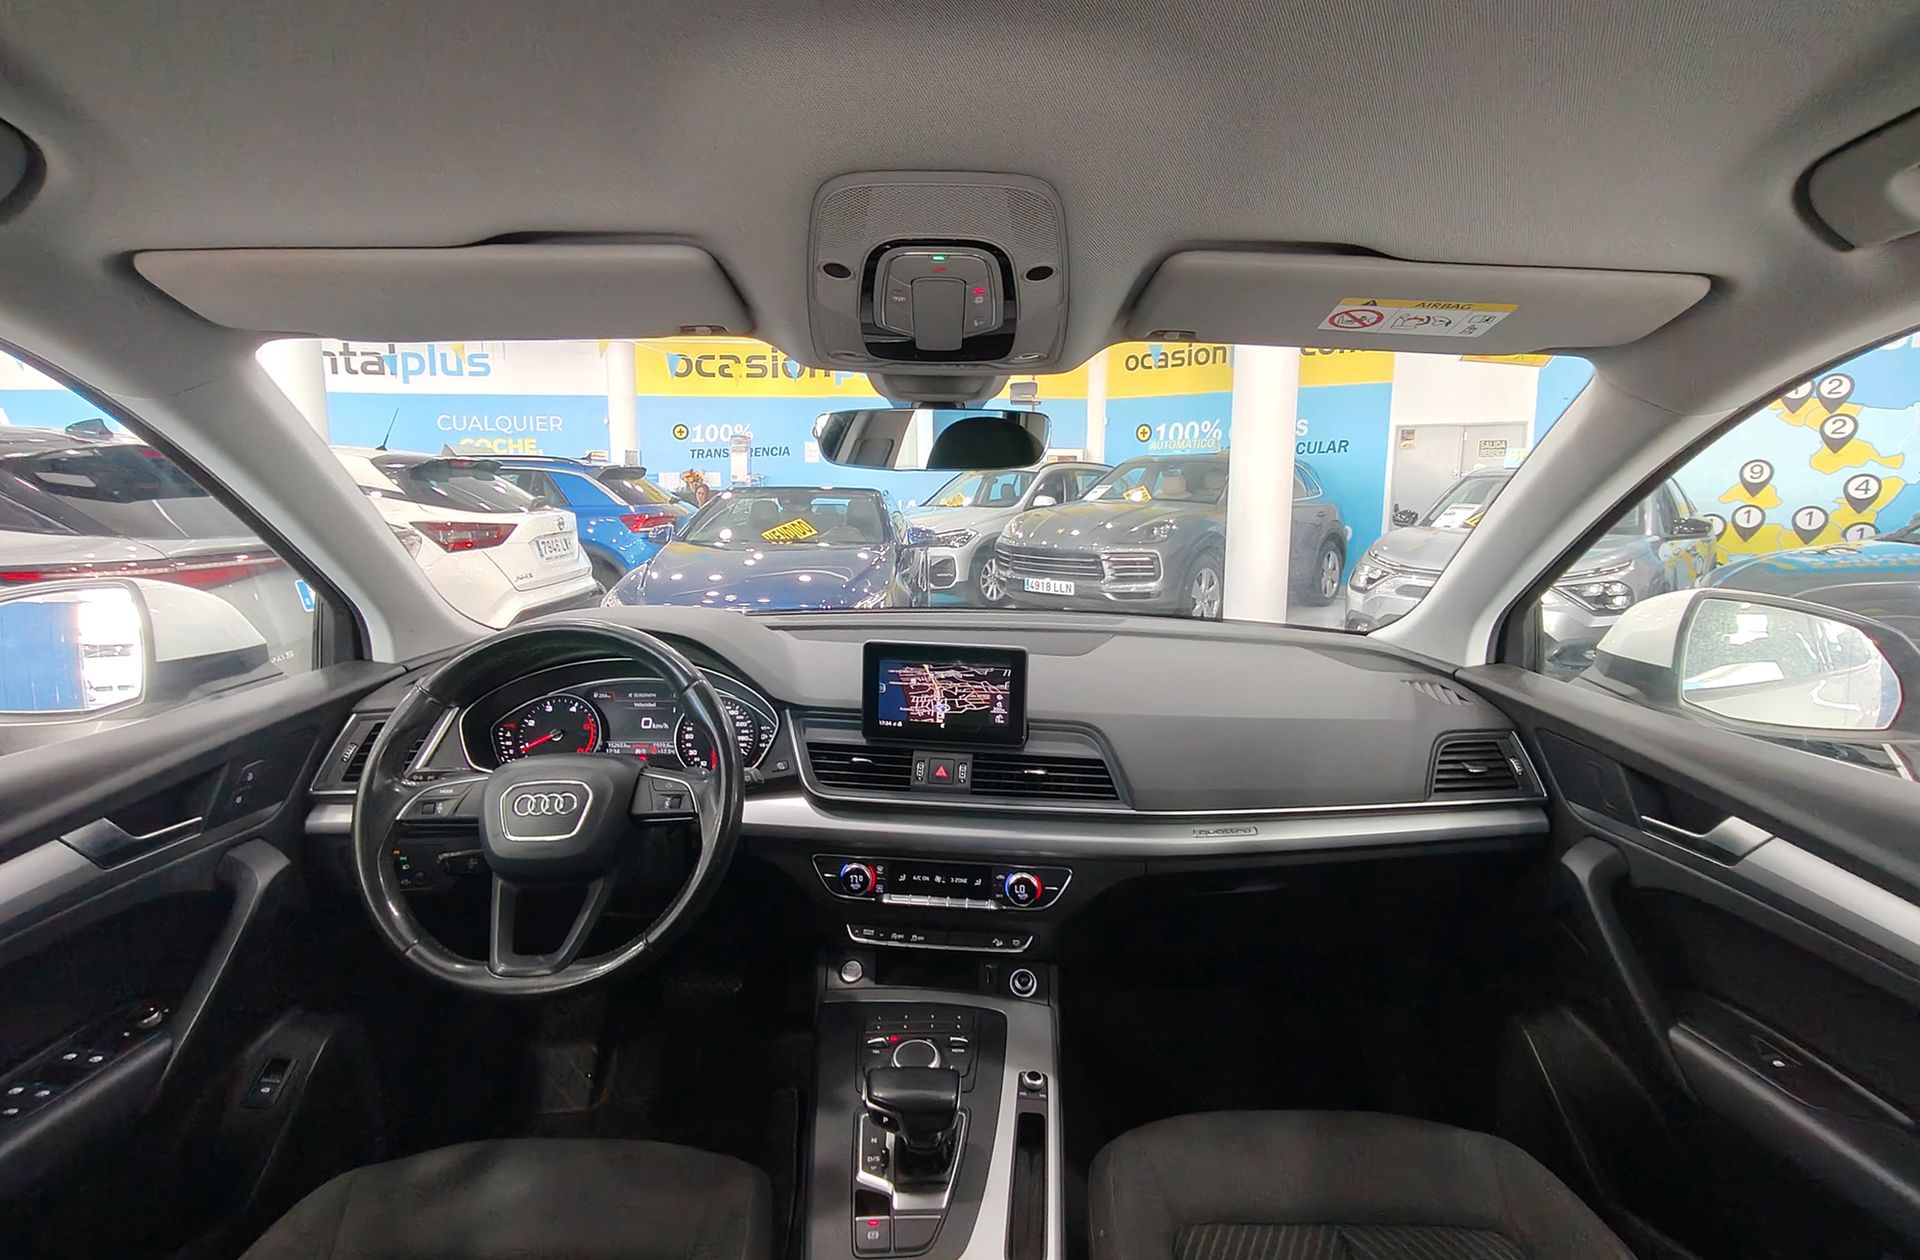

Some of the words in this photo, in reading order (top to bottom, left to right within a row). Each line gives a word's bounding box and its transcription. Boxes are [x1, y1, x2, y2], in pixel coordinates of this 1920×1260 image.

[1415, 302, 1472, 310] AIRBAG
[1125, 343, 1234, 371] ocasion
[1827, 378, 1843, 395] 2
[436, 414, 564, 434] CUALQUIER
[1156, 419, 1222, 442] 100%
[1831, 418, 1846, 435] 2
[691, 423, 753, 443] 100%
[690, 446, 790, 459] TRANSRENCIA
[1480, 440, 1507, 449] SALIDA
[1749, 464, 1764, 480] 9
[1854, 479, 1871, 495] 4
[1744, 510, 1752, 524] 1
[1805, 511, 1814, 527] 1
[764, 521, 814, 540] VENDIDO
[1030, 580, 1050, 591] 4918
[1053, 582, 1072, 593] LLN
[641, 717, 653, 729] 0
